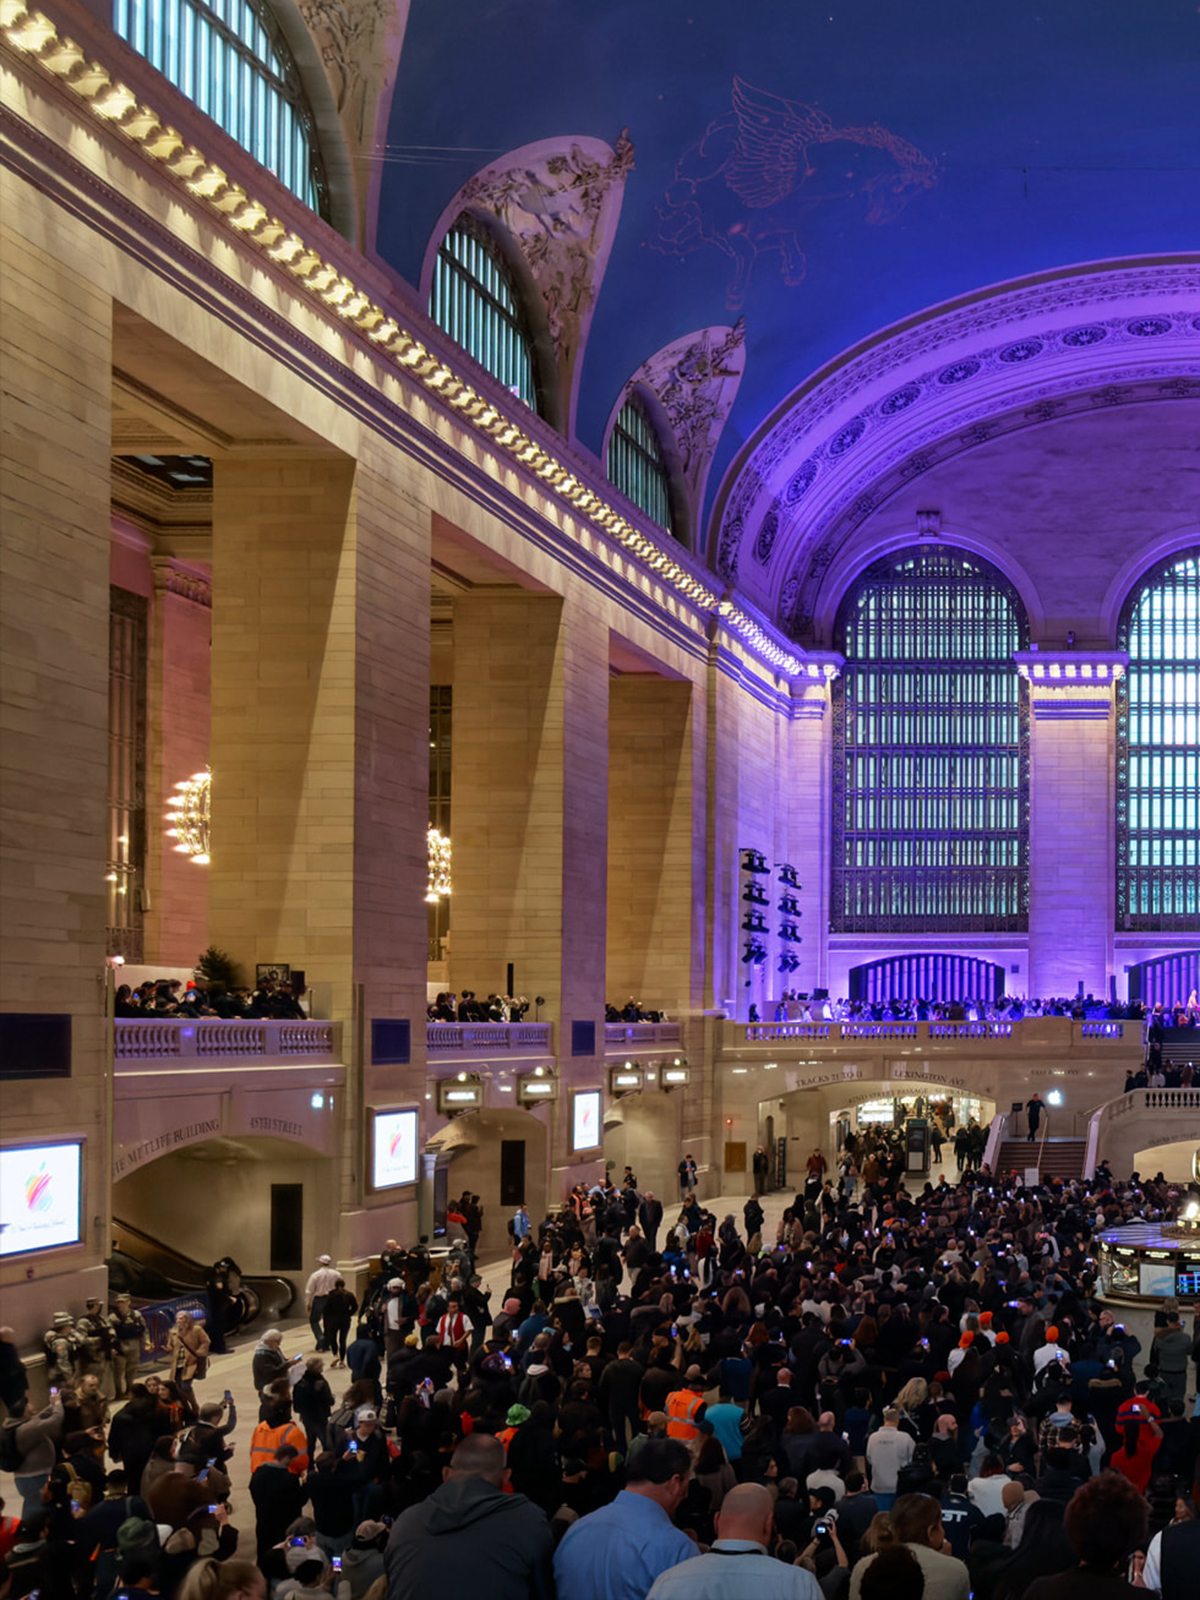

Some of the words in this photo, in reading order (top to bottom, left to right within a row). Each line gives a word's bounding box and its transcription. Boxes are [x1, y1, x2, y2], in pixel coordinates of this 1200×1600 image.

[796, 1075, 829, 1087] TRACKS
[895, 1069, 947, 1083] LEXINGTON
[173, 1120, 219, 1143] BUILDING
[273, 1118, 303, 1136] STREET
